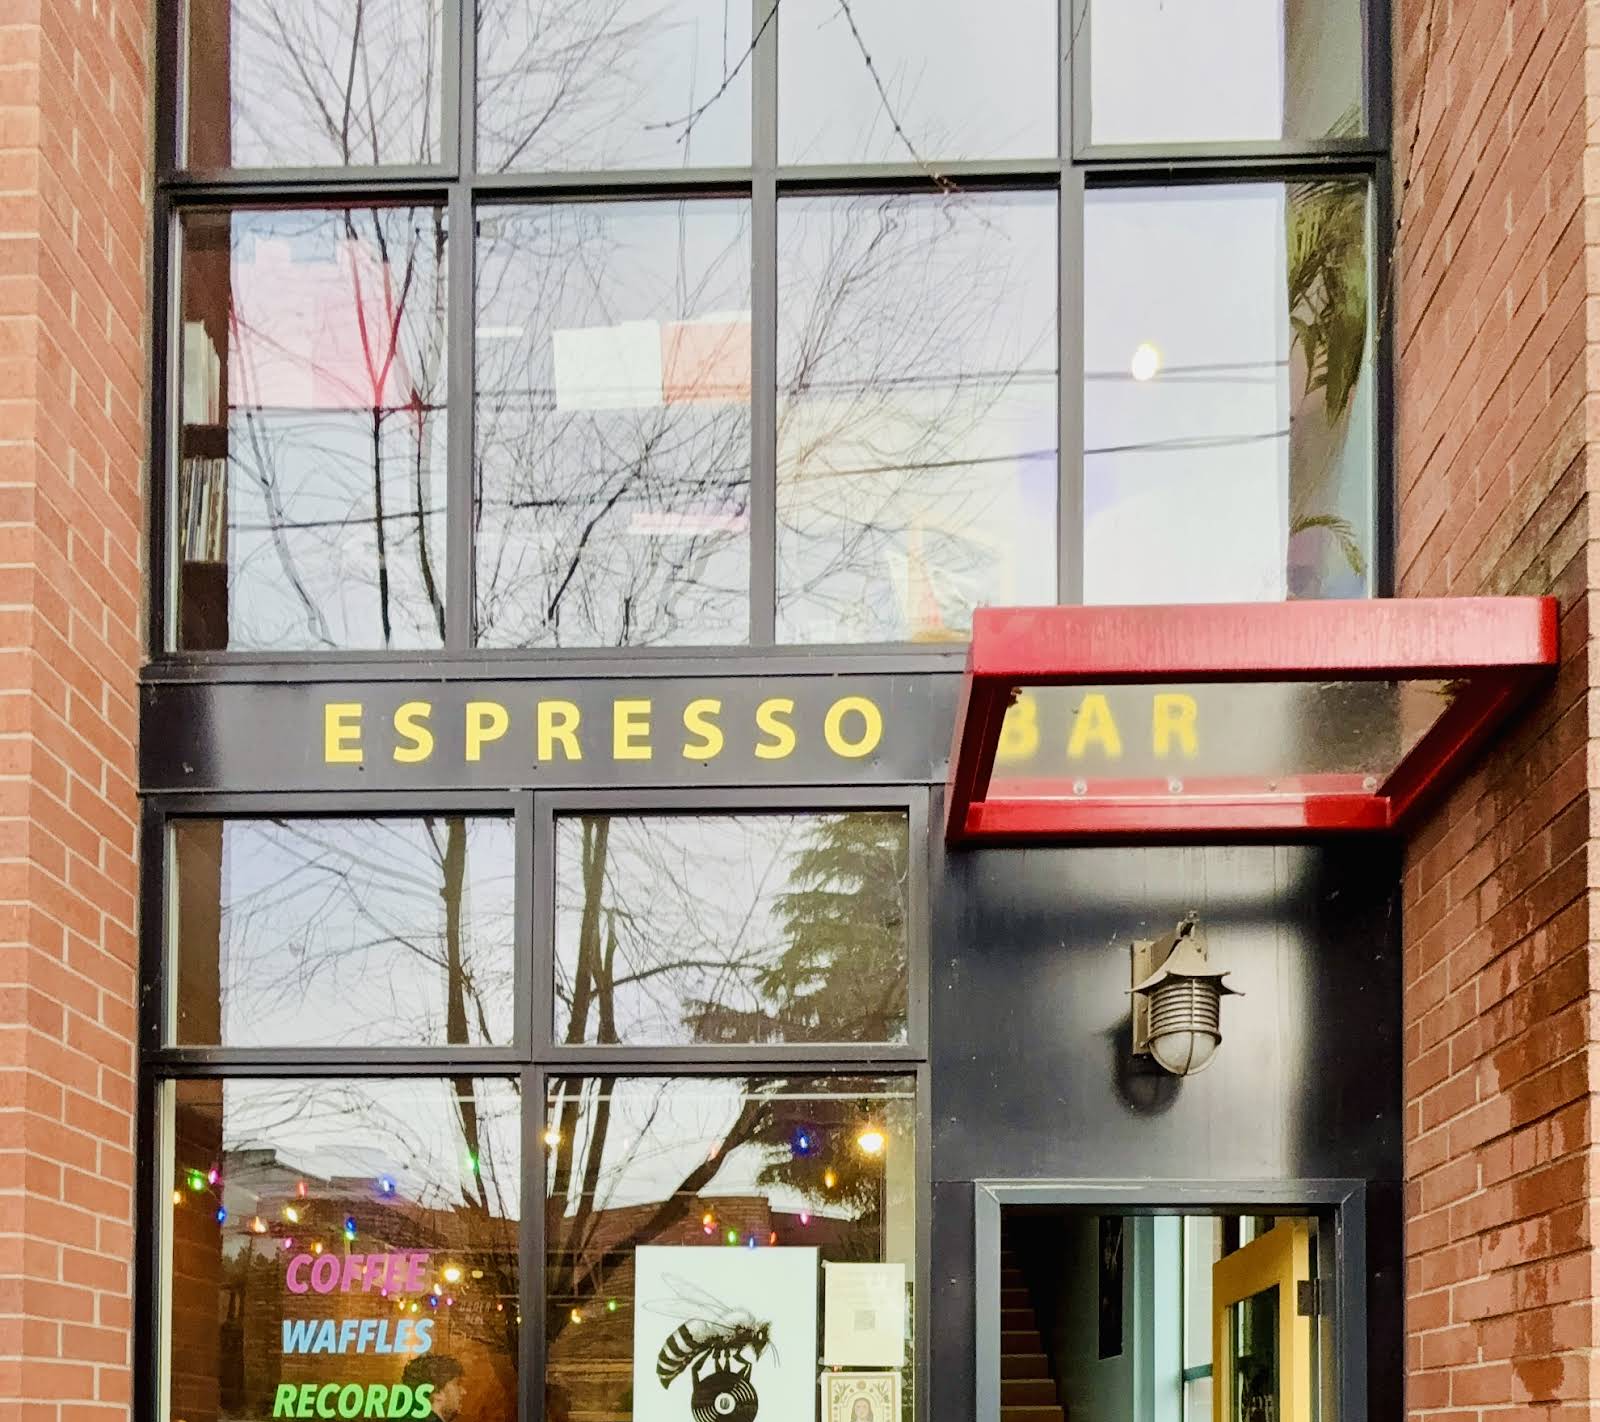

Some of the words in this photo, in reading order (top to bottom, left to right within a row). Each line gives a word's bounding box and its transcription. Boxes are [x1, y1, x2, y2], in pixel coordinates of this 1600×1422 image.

[324, 697, 882, 763] ESPRESSO
[998, 692, 1199, 759] BAR
[286, 1253, 429, 1294] COFFEE
[281, 1318, 435, 1354] WAFFLES
[272, 1383, 435, 1419] RECORDS
